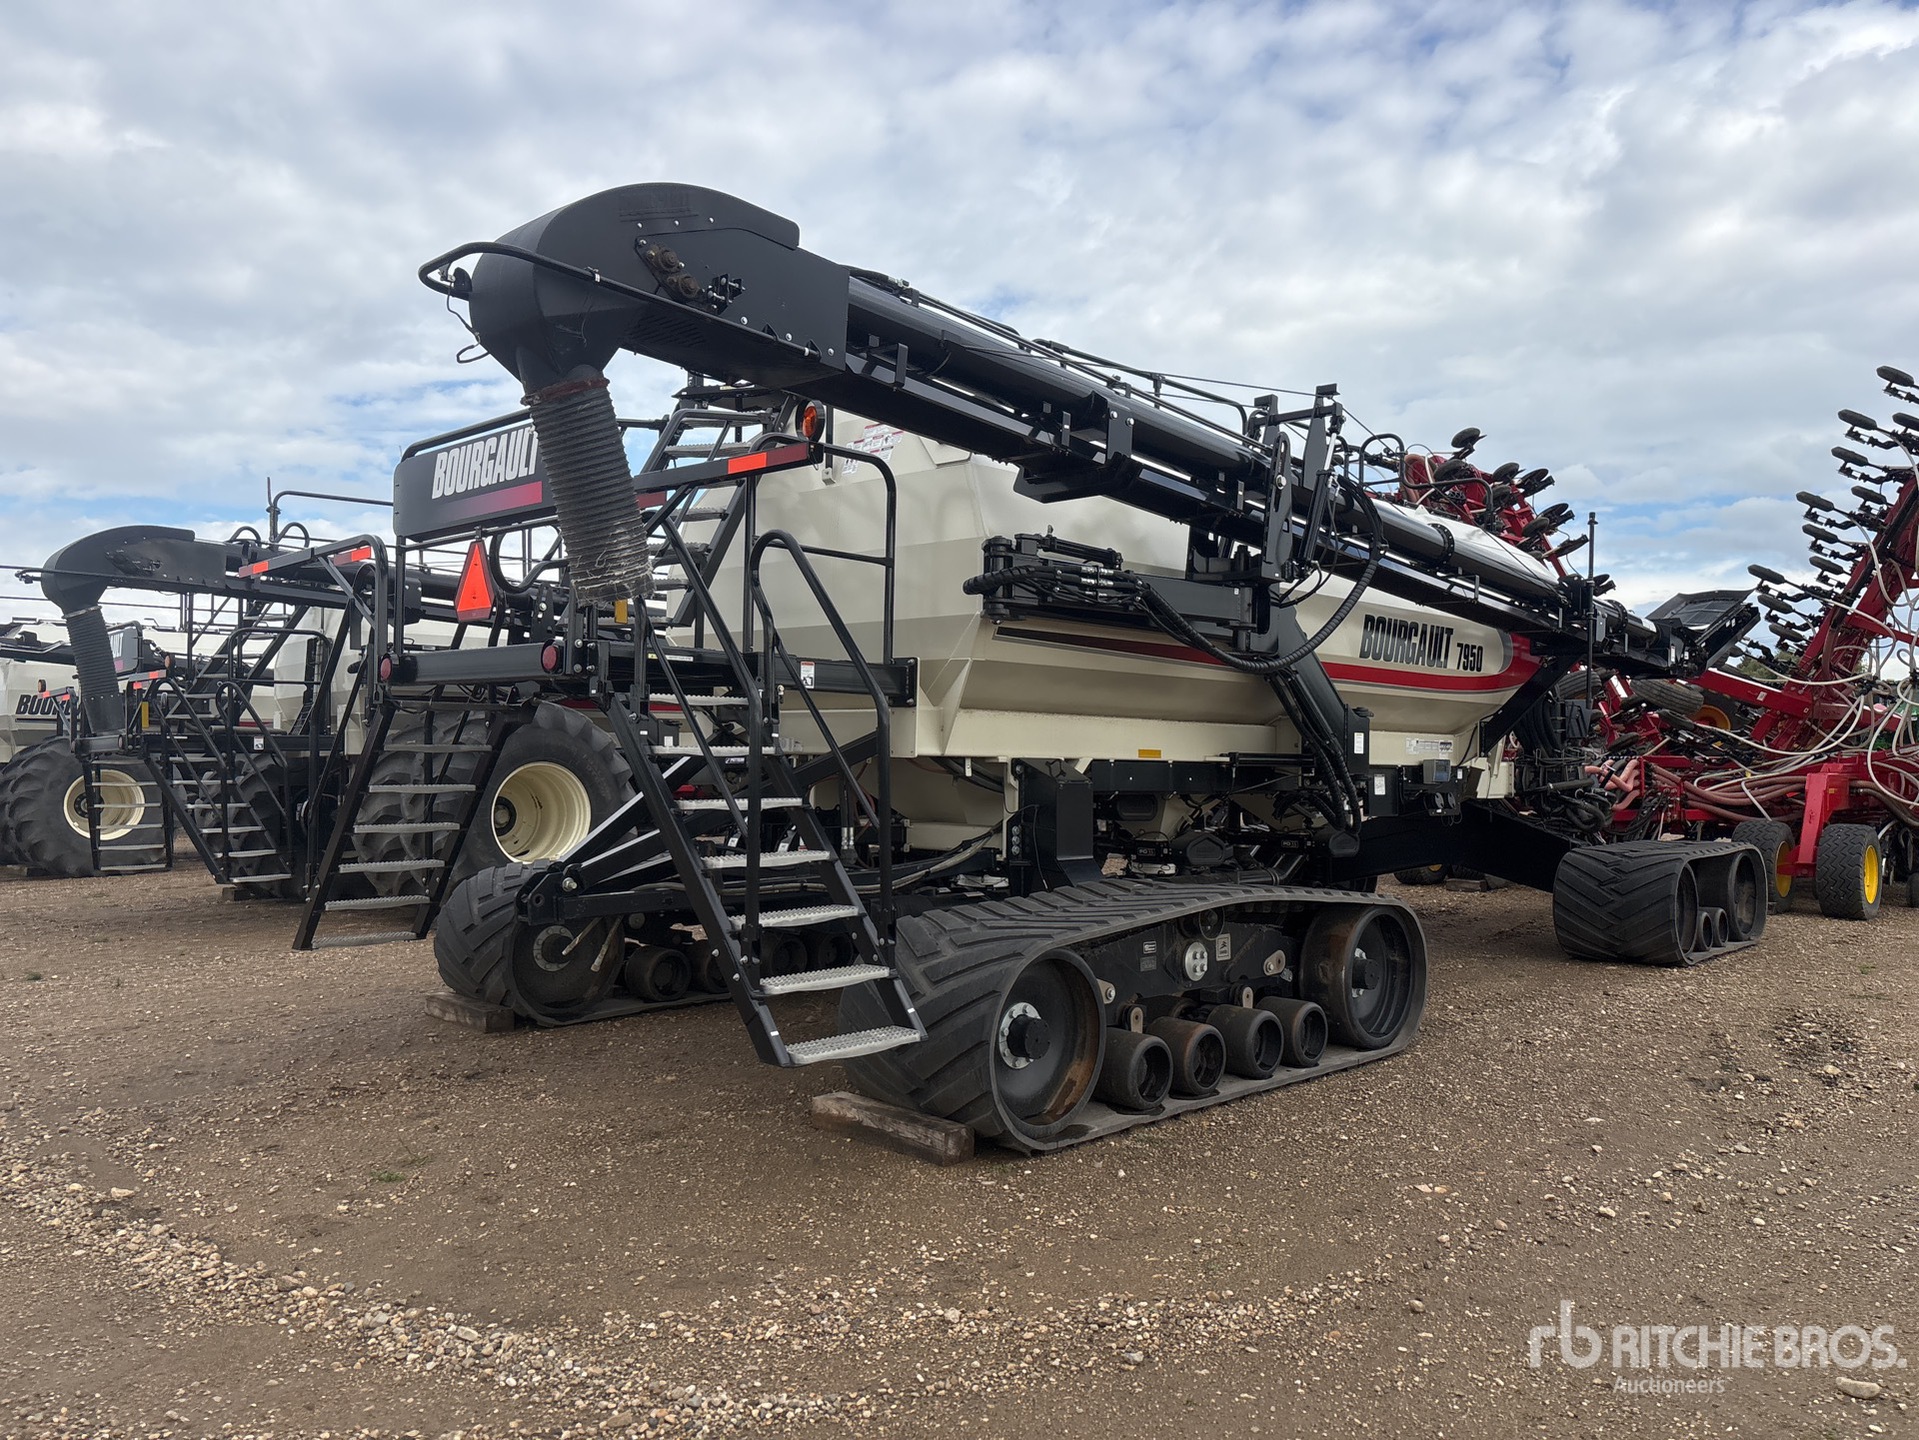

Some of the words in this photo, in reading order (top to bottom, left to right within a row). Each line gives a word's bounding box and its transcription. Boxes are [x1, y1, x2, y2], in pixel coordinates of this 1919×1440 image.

[431, 426, 539, 500] BOURGAULT
[1359, 613, 1454, 669] BOURGAULT
[1456, 642, 1484, 672] 7950
